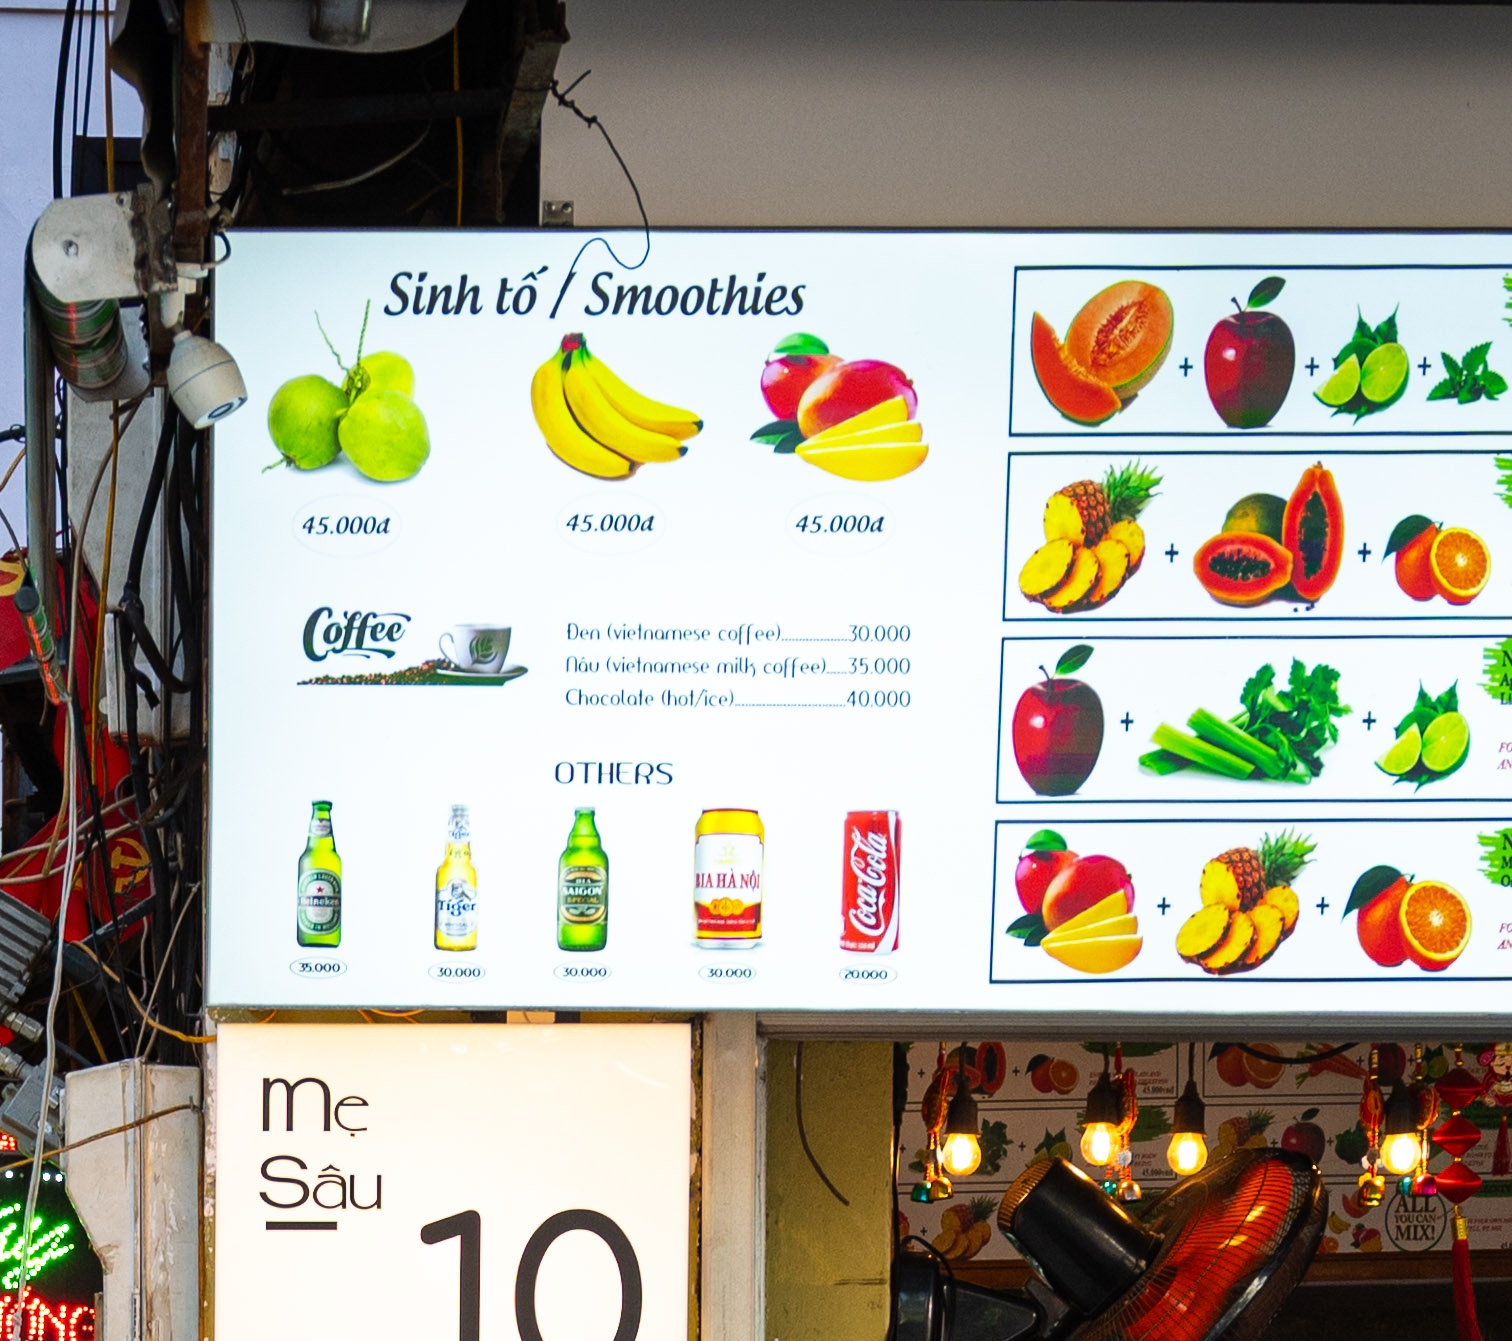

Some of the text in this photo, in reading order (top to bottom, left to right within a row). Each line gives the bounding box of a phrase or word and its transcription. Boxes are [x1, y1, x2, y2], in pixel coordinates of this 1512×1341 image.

[383, 271, 483, 317] Sinh
[495, 266, 549, 317] tố
[584, 271, 807, 317] Smoothies
[303, 605, 411, 663] Coffee
[554, 761, 674, 785] OTHERS
[716, 868, 736, 889] HÀ
[438, 900, 475, 916] Tiger
[259, 1155, 382, 1210] Sâu
